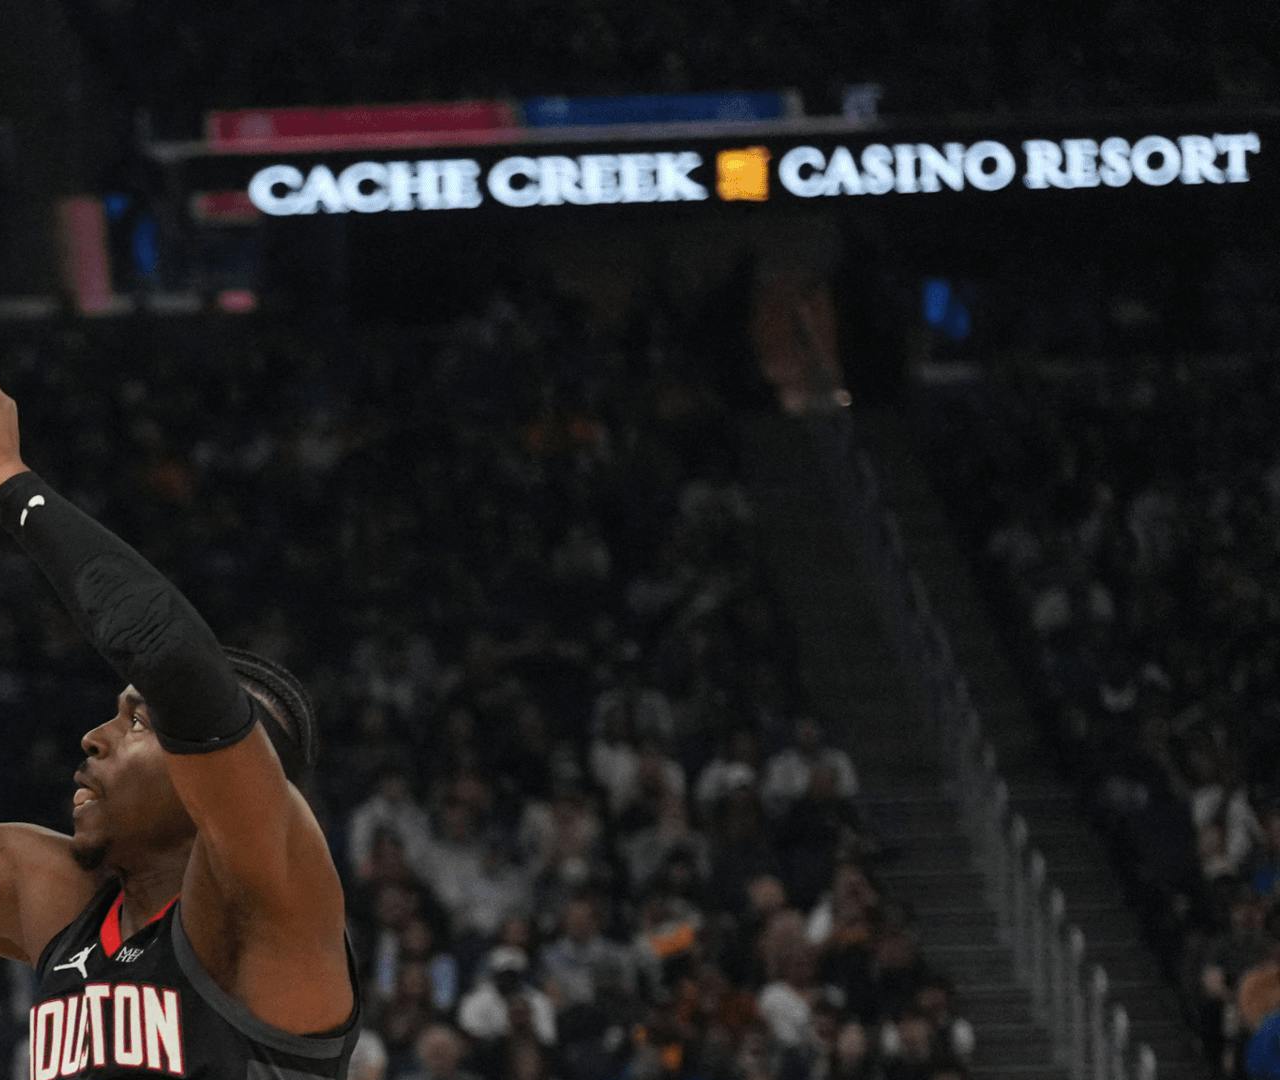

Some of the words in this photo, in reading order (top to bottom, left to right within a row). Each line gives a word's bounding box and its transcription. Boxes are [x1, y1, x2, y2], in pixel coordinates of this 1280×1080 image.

[248, 160, 482, 217] CACHE
[488, 151, 707, 206] CREEK
[778, 141, 1015, 198] CASINO
[1024, 133, 1260, 188] RESORT
